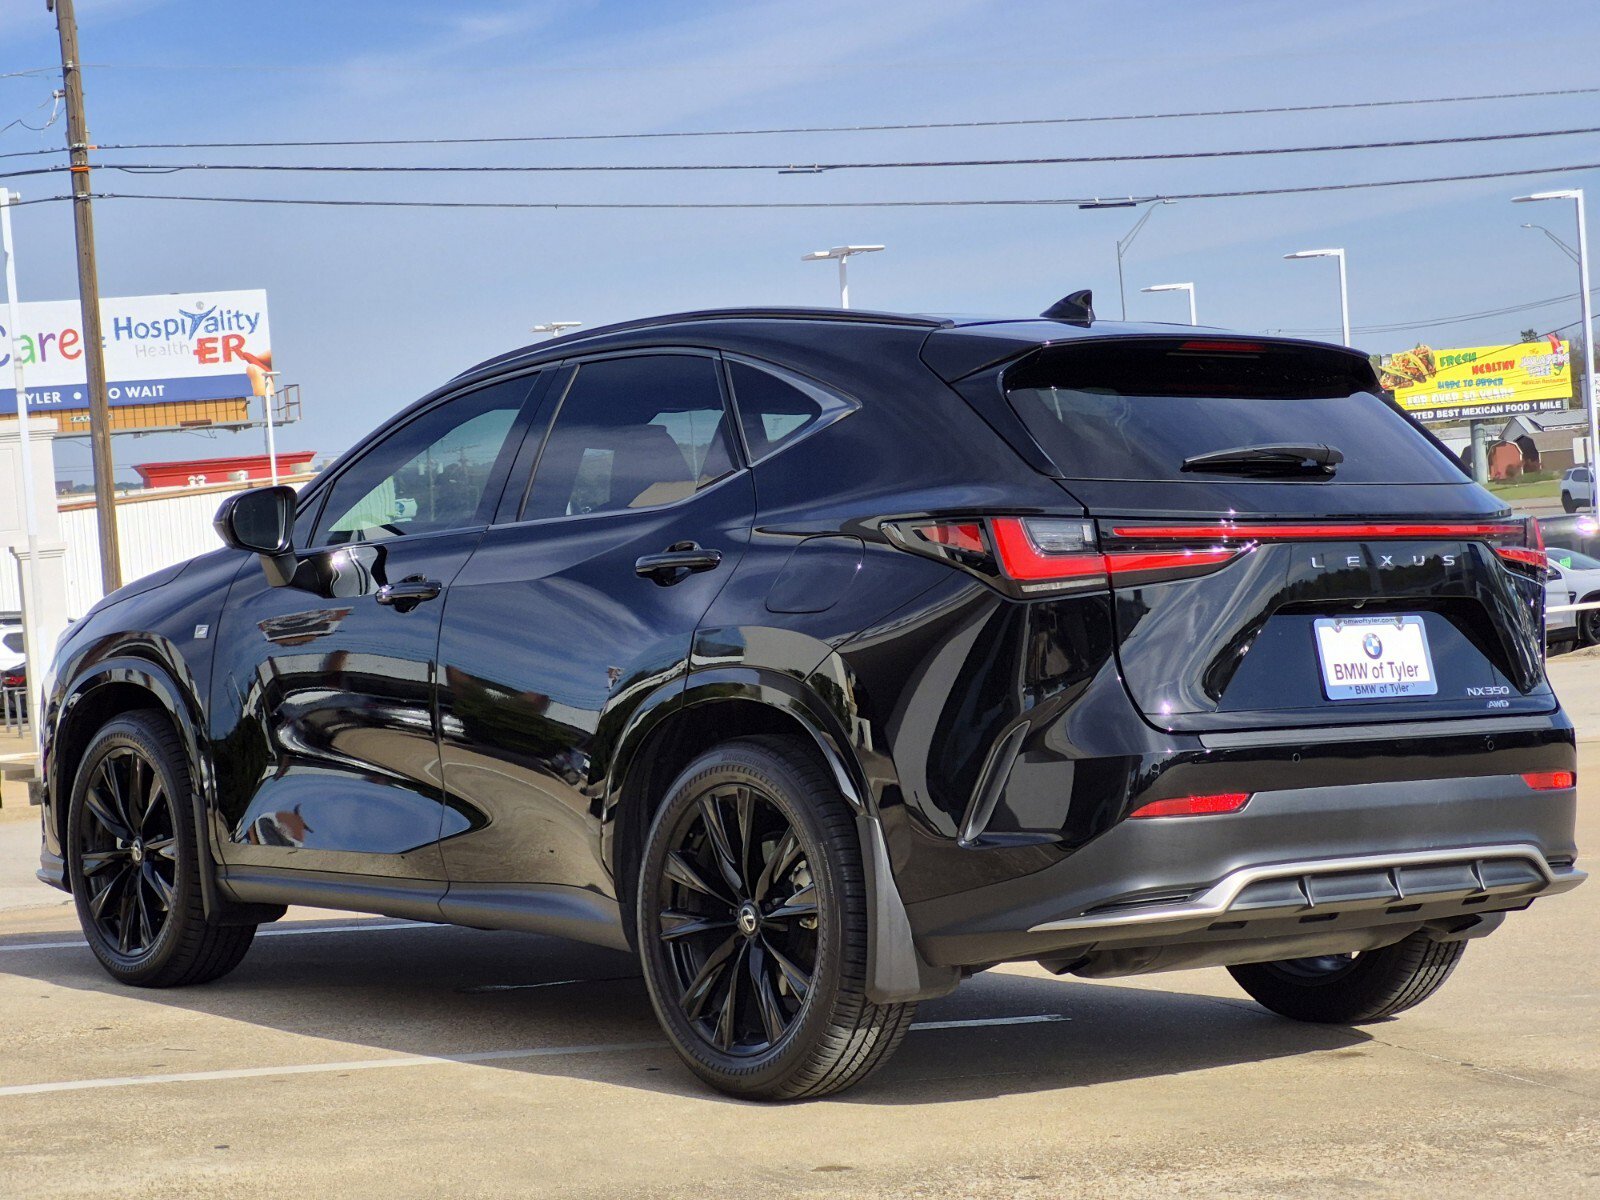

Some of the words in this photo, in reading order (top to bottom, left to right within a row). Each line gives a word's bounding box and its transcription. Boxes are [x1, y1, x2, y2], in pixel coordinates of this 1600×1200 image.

[0, 325, 82, 367] are
[135, 341, 190, 358] Health
[193, 333, 246, 365] ER
[1440, 352, 1477, 367] FRESH
[1471, 360, 1515, 375] HEALTHY
[1463, 379, 1474, 388] TO
[1476, 377, 1504, 387] ORDER
[25, 391, 62, 405] YLER
[108, 387, 120, 400] O
[125, 384, 165, 398] WAIT
[1406, 394, 1428, 406] FOR
[1431, 391, 1459, 404] OVER
[1410, 410, 1435, 420] OTED
[1436, 408, 1460, 418] BEST
[1462, 404, 1504, 416] MEXICAN
[1505, 402, 1530, 413] FOOD
[1532, 402, 1537, 410] 1
[1540, 400, 1562, 410] MILE
[1311, 555, 1456, 569] LEXUS
[1333, 662, 1367, 681] BMW
[1372, 662, 1384, 679] of
[1387, 661, 1419, 682] Tyler
[1355, 684, 1376, 695] BMW
[1379, 684, 1388, 694] of
[1390, 683, 1409, 694] Tyler
[1466, 685, 1510, 696] NX350
[1487, 699, 1510, 708] AWD
